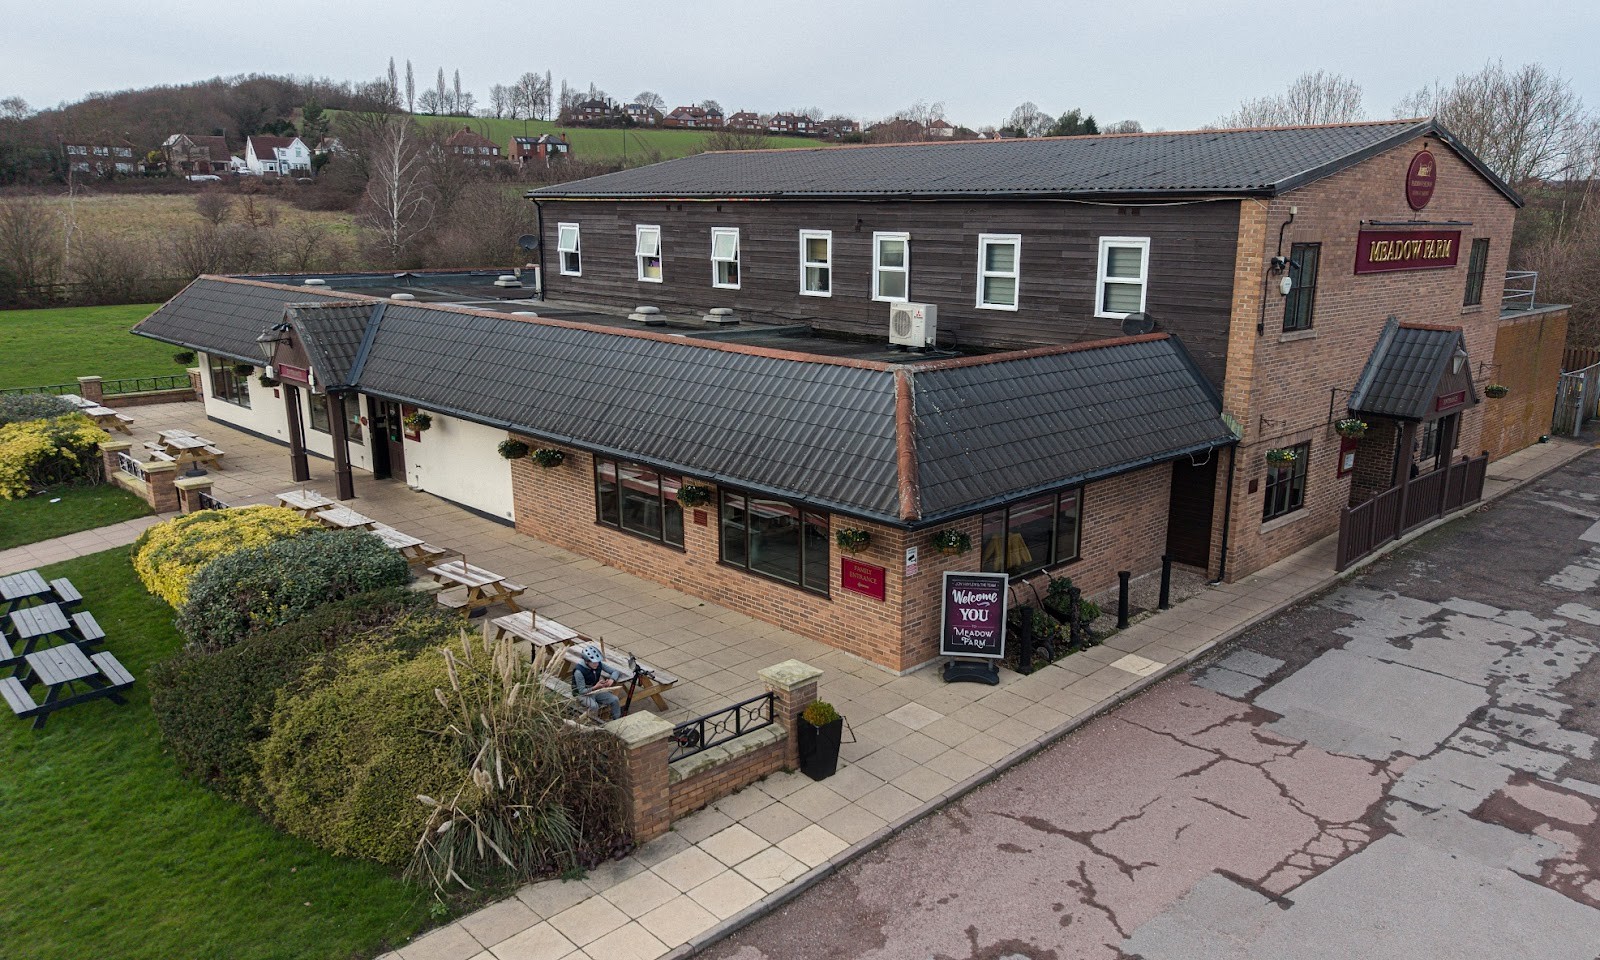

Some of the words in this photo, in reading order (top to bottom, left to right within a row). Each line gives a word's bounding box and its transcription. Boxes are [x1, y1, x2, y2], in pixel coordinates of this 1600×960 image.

[1369, 240, 1422, 262] MEADOW
[1423, 239, 1452, 259] FARM
[854, 565, 873, 575] FAMILY
[849, 571, 877, 584] ENTRANCE
[952, 589, 998, 605] Welcome
[959, 608, 989, 622] YOU
[953, 627, 994, 638] MEADOW
[961, 637, 986, 649] FARM
